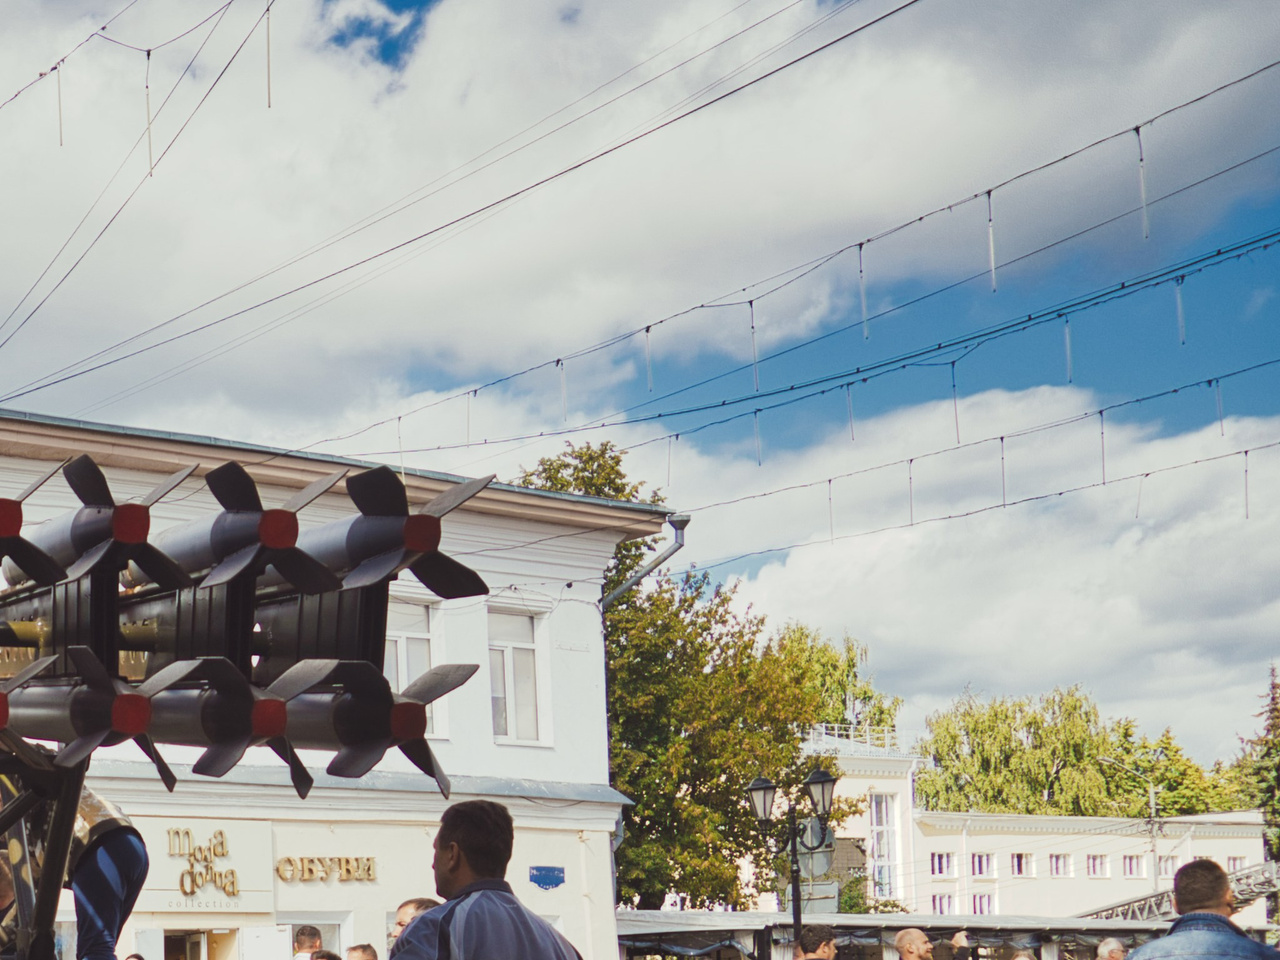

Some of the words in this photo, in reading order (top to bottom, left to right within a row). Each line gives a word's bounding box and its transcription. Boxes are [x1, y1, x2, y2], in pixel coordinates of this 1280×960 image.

[167, 827, 229, 863] moda
[179, 857, 239, 897] donna
[276, 856, 376, 882] ОБУВИ
[168, 899, 239, 908] collection
